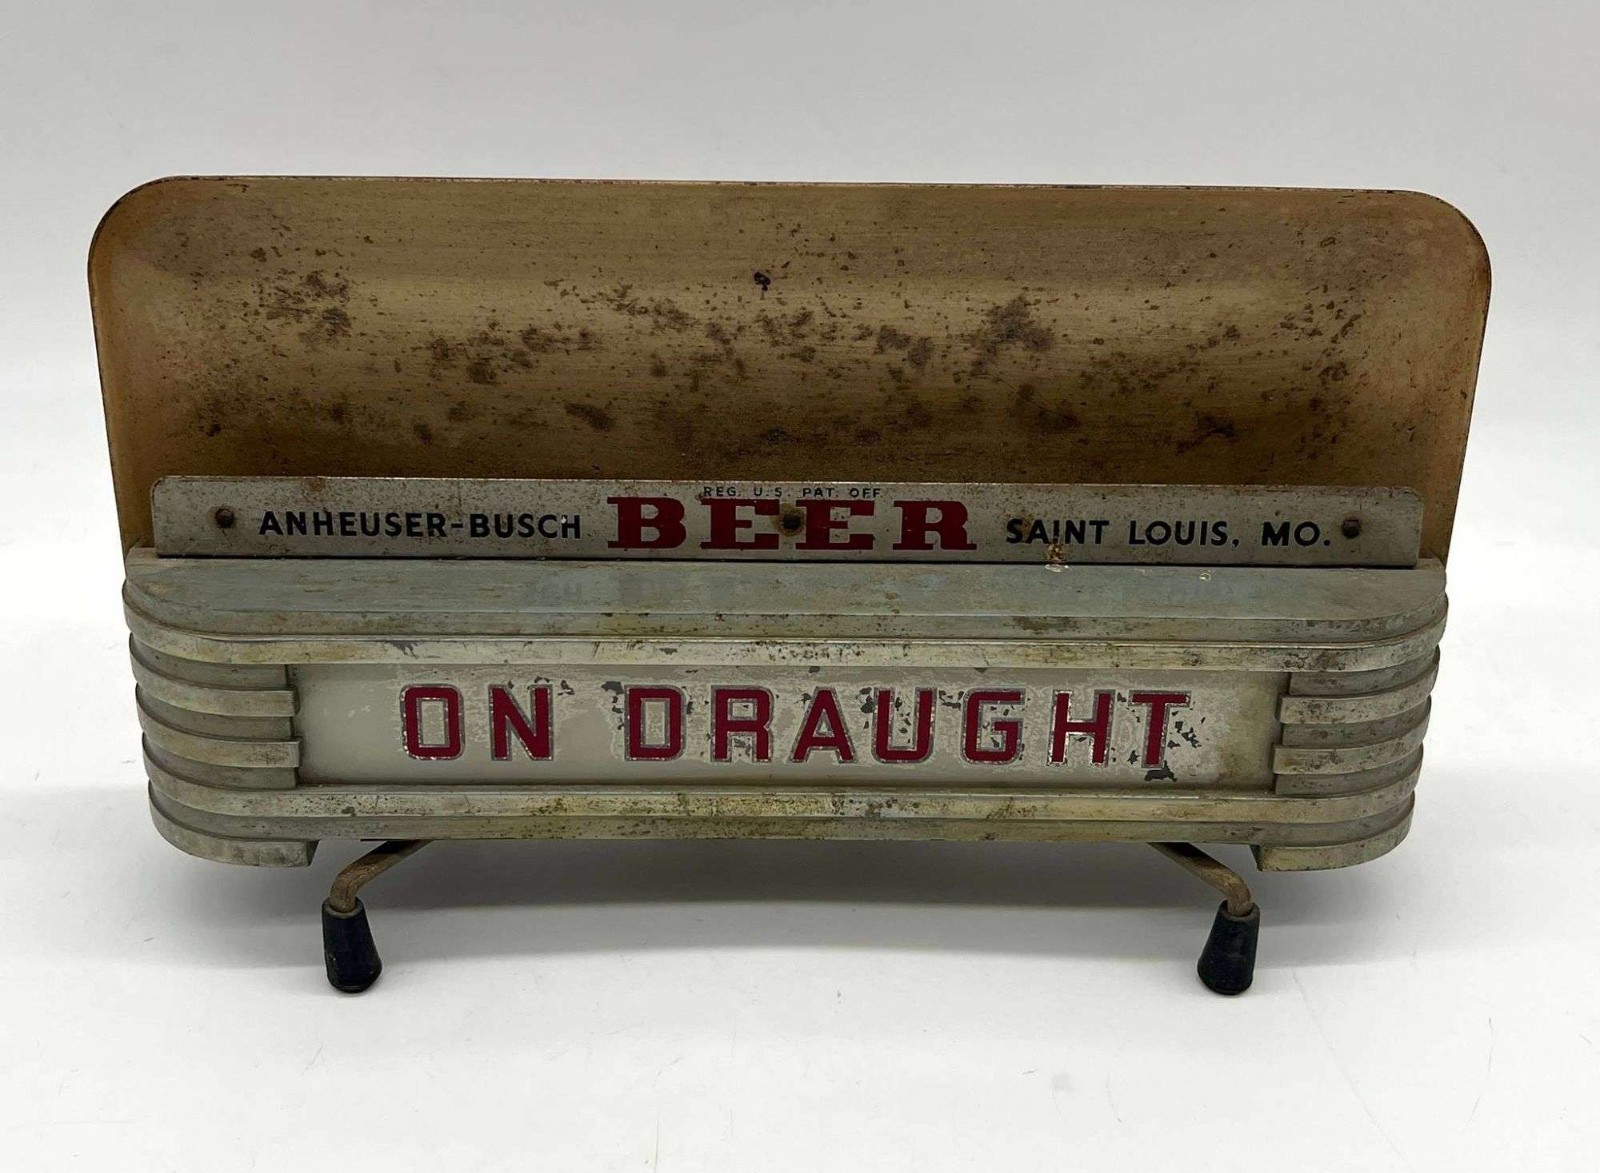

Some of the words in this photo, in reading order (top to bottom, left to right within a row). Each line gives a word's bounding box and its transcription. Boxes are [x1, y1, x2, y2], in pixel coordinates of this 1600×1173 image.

[703, 486, 741, 498] REG.
[258, 511, 582, 539] ANHEUSER-BUSCH
[607, 497, 978, 551] BEER
[1006, 519, 1109, 545] SAINT
[1128, 520, 1239, 549] LOUIS,
[1261, 521, 1331, 548] MO.
[400, 684, 554, 762] ON
[624, 684, 1192, 769] DRAUGHT
